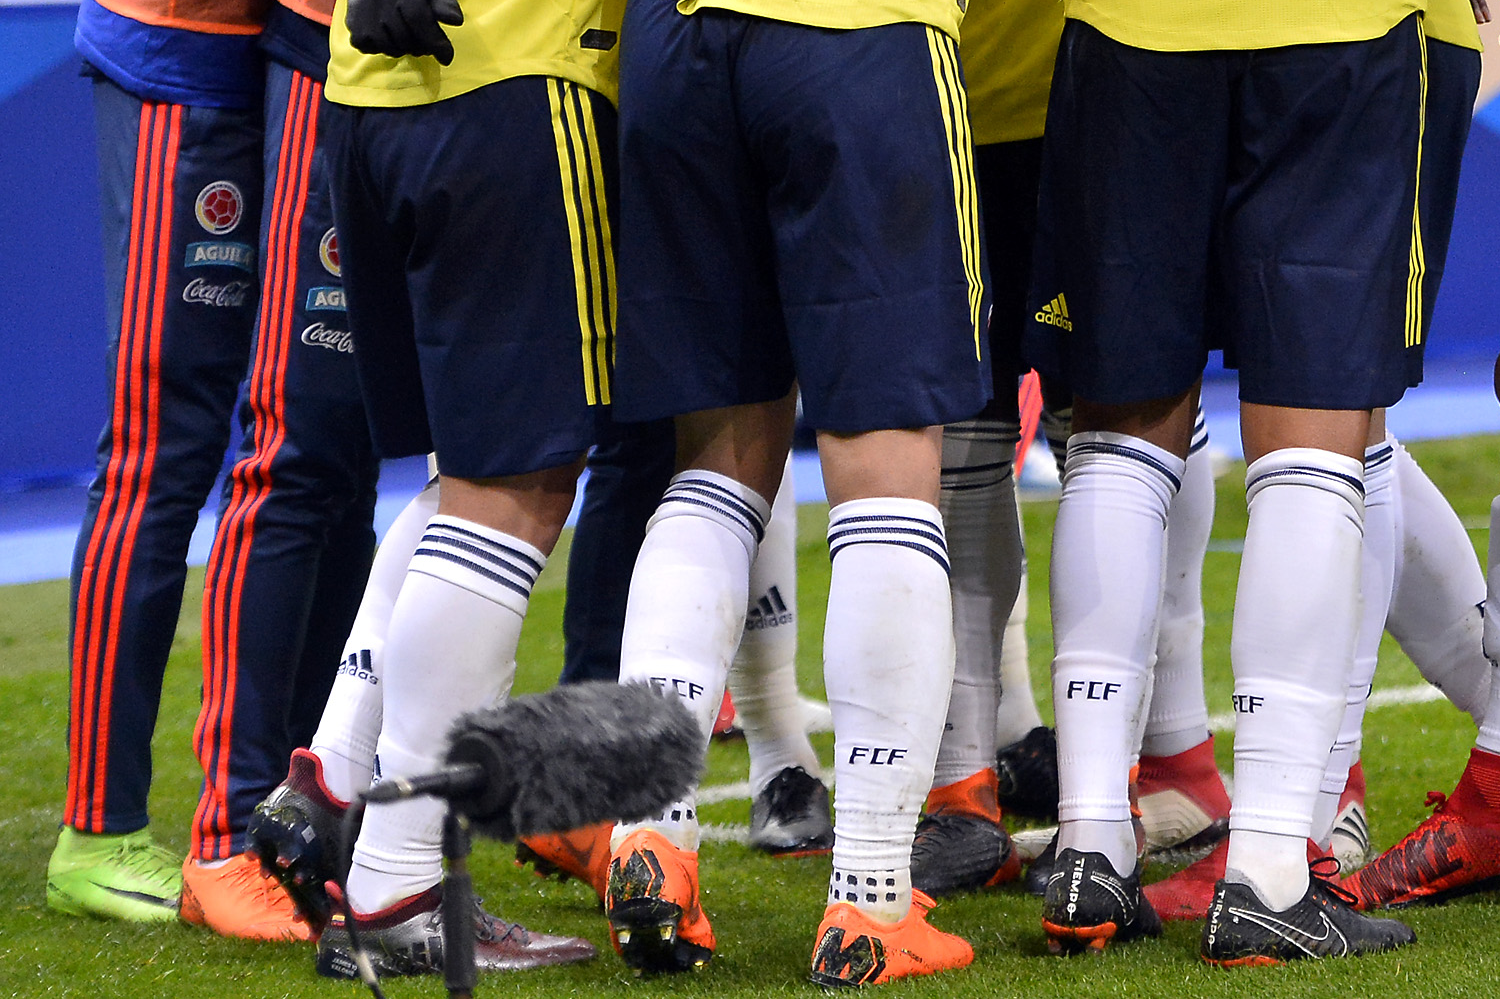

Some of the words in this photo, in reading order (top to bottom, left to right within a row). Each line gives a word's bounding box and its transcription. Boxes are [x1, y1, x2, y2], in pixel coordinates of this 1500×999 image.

[1034, 311, 1073, 332] adidas
[1066, 680, 1122, 701] FCF
[848, 746, 908, 765] FCF
[1066, 857, 1085, 916] TIEMPO
[1207, 889, 1226, 945] TIEMPO
